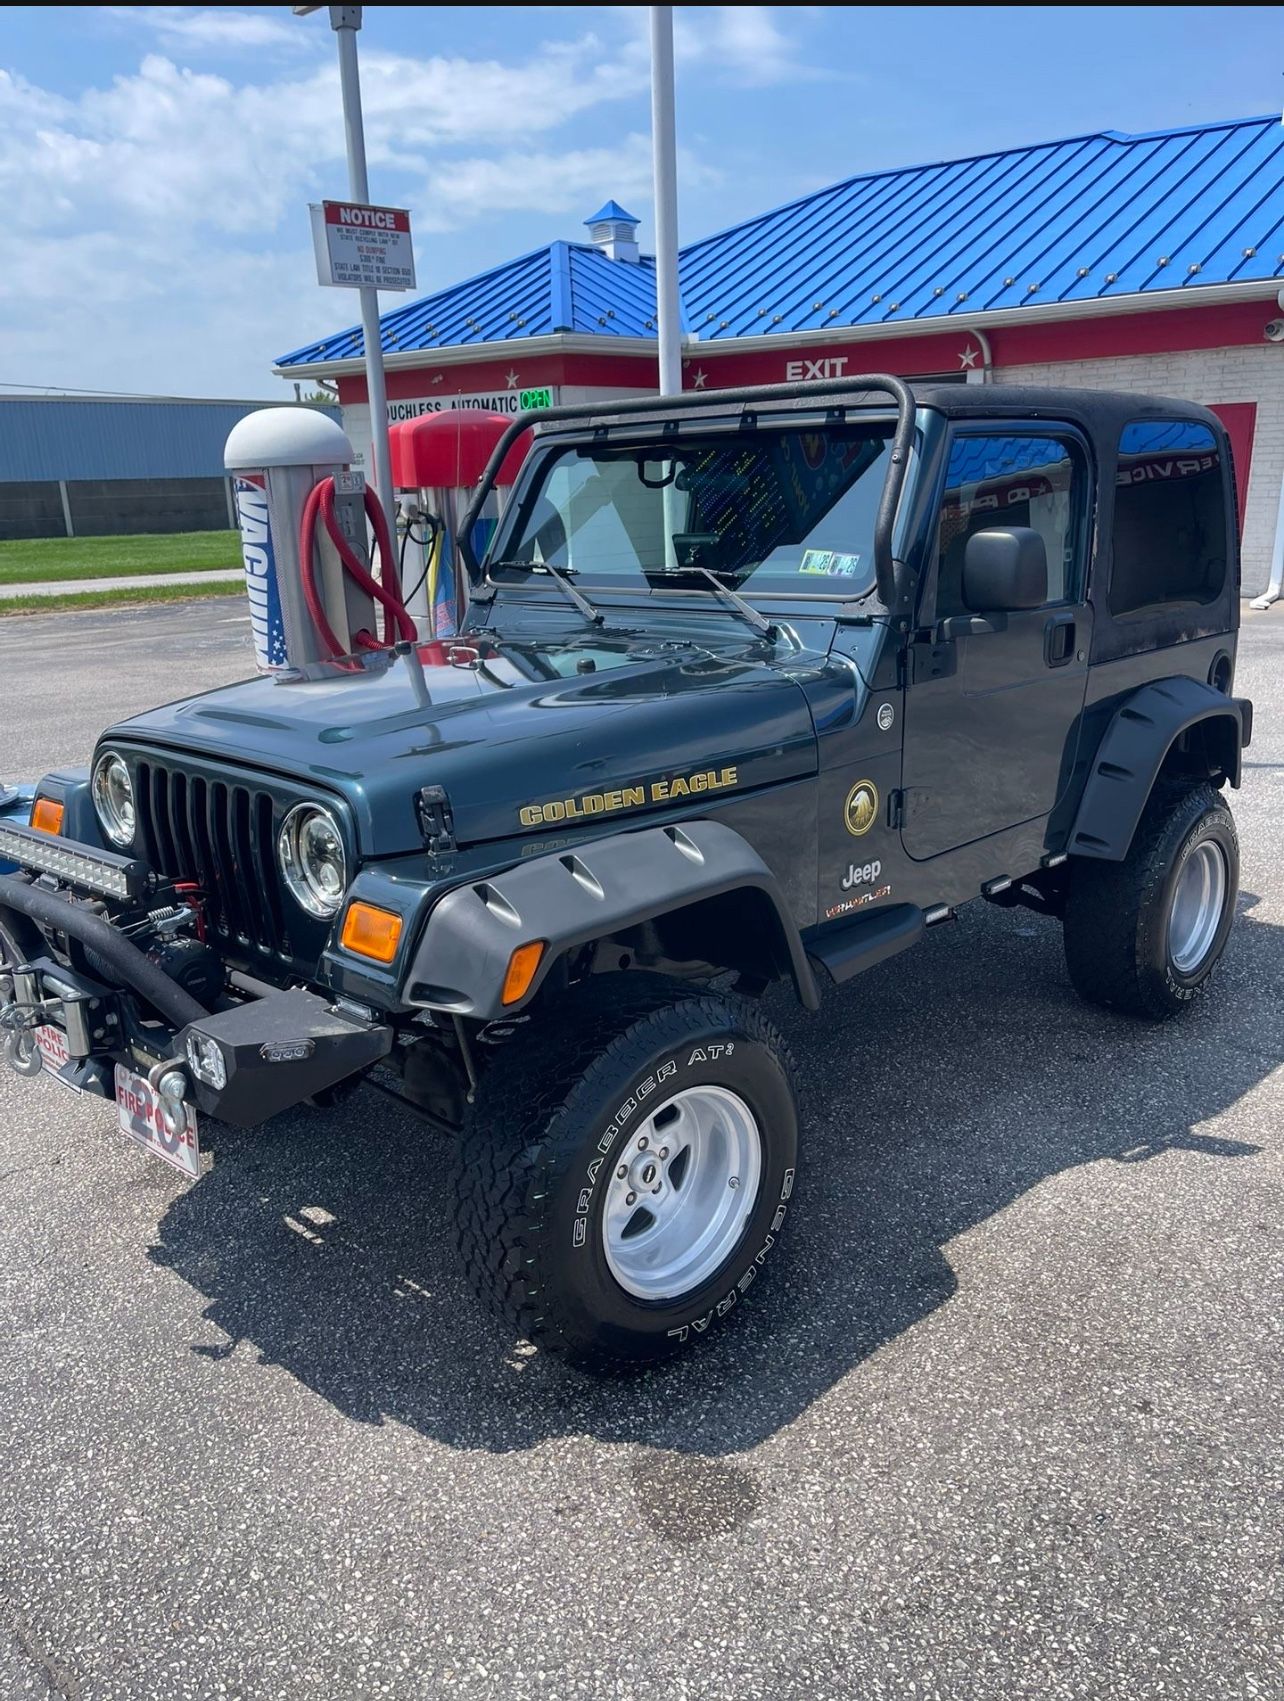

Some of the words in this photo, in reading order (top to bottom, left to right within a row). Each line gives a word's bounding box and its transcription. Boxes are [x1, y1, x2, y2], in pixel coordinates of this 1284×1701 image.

[340, 207, 396, 229] NOTICE
[786, 357, 848, 381] EXIT
[387, 401, 441, 420] UCHLESS
[520, 389, 550, 409] OPEN
[238, 491, 270, 668] VACUUM
[520, 786, 645, 826] GOLDEN
[651, 767, 738, 801] EAGLE
[842, 861, 881, 887] Jeep
[36, 1034, 70, 1061] POLIC
[42, 1026, 63, 1047] FIRE
[118, 1086, 143, 1117] FIRE
[573, 1060, 677, 1248] GRABBER
[667, 1168, 794, 1342] GENERAL
